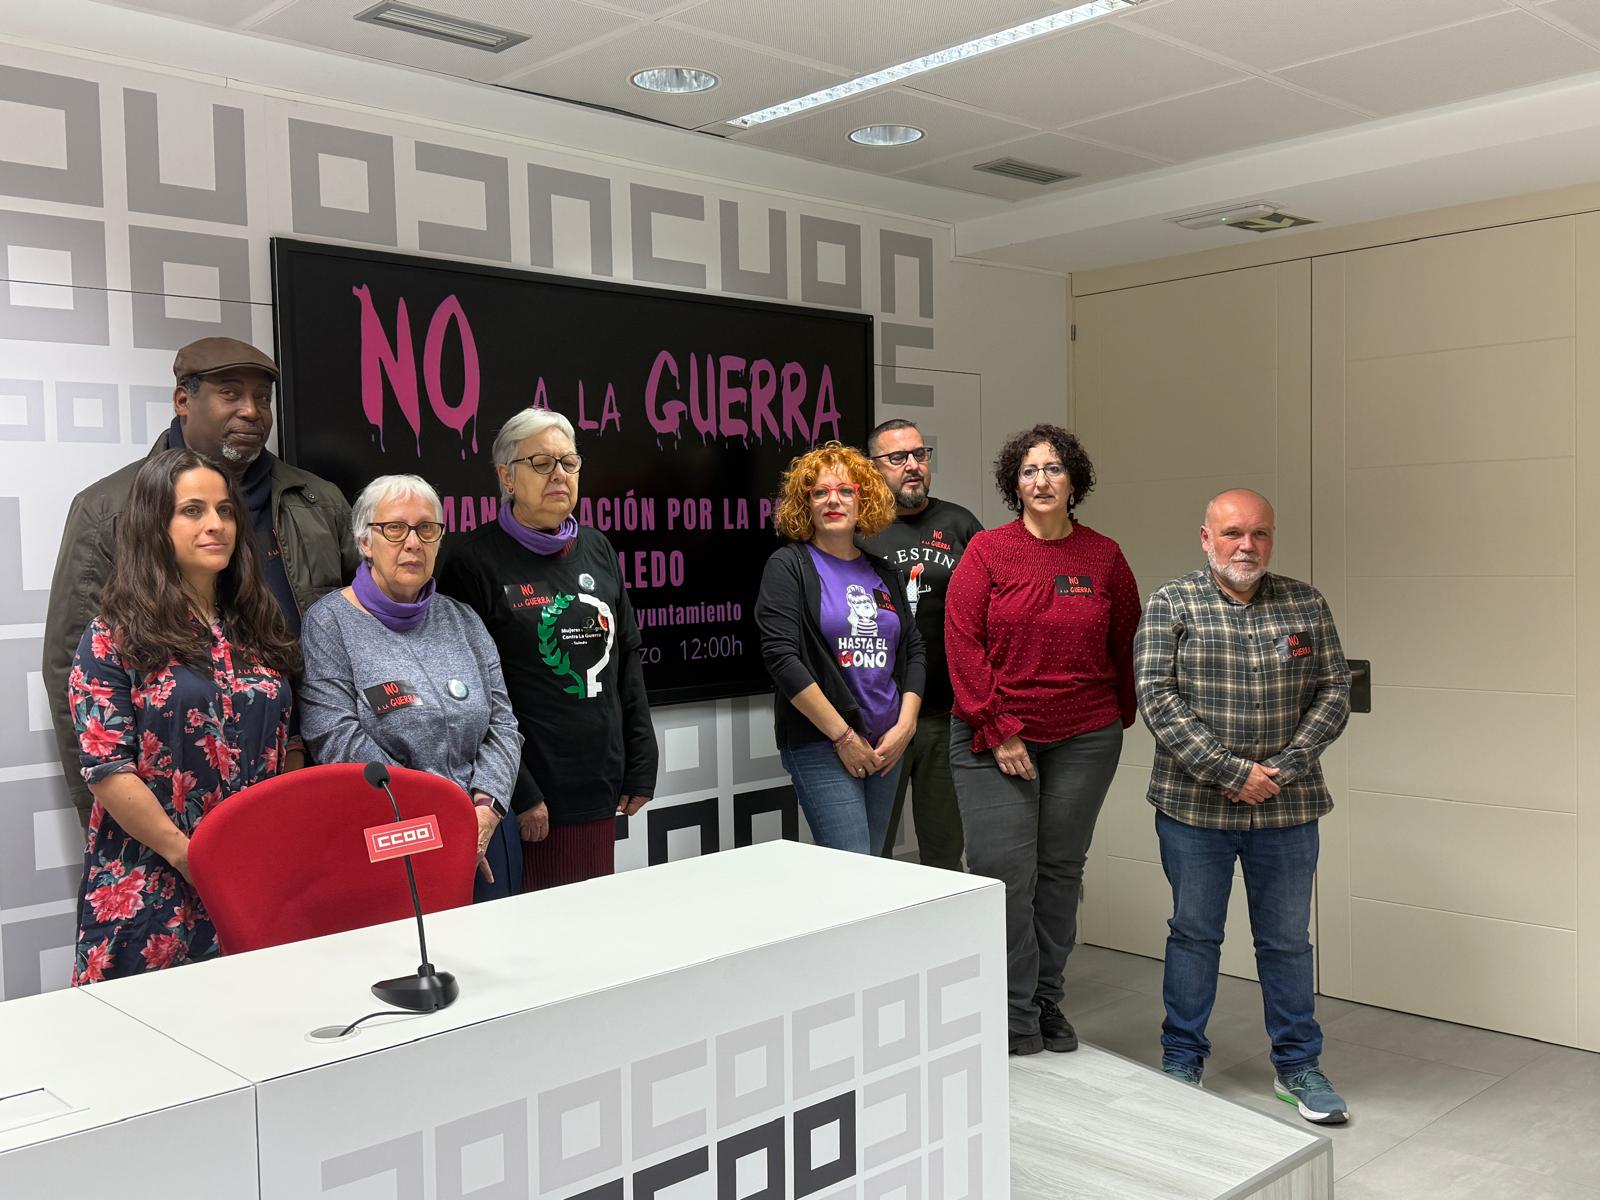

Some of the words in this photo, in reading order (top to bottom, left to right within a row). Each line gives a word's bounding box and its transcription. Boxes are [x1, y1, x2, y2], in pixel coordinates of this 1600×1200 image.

[352, 283, 480, 458] NO
[578, 379, 621, 436] LA
[645, 350, 841, 450] GUERRA
[667, 498, 712, 530] POR
[723, 498, 749, 530] LA
[932, 529, 943, 540] NO
[931, 540, 951, 551] GUERRA
[618, 550, 685, 589] LEDO
[1068, 576, 1079, 585] NO
[520, 583, 535, 596] NO
[1070, 586, 1092, 594] GUERRA
[524, 596, 551, 607] GUERRA
[636, 601, 742, 631] yuntamiento
[838, 637, 875, 650] HASTA
[876, 638, 889, 650] EL
[1287, 633, 1300, 647] NO
[680, 634, 743, 660] 12:00h
[382, 682, 399, 695] NO
[390, 694, 417, 707] GUERRA
[377, 827, 430, 848] CCOO
